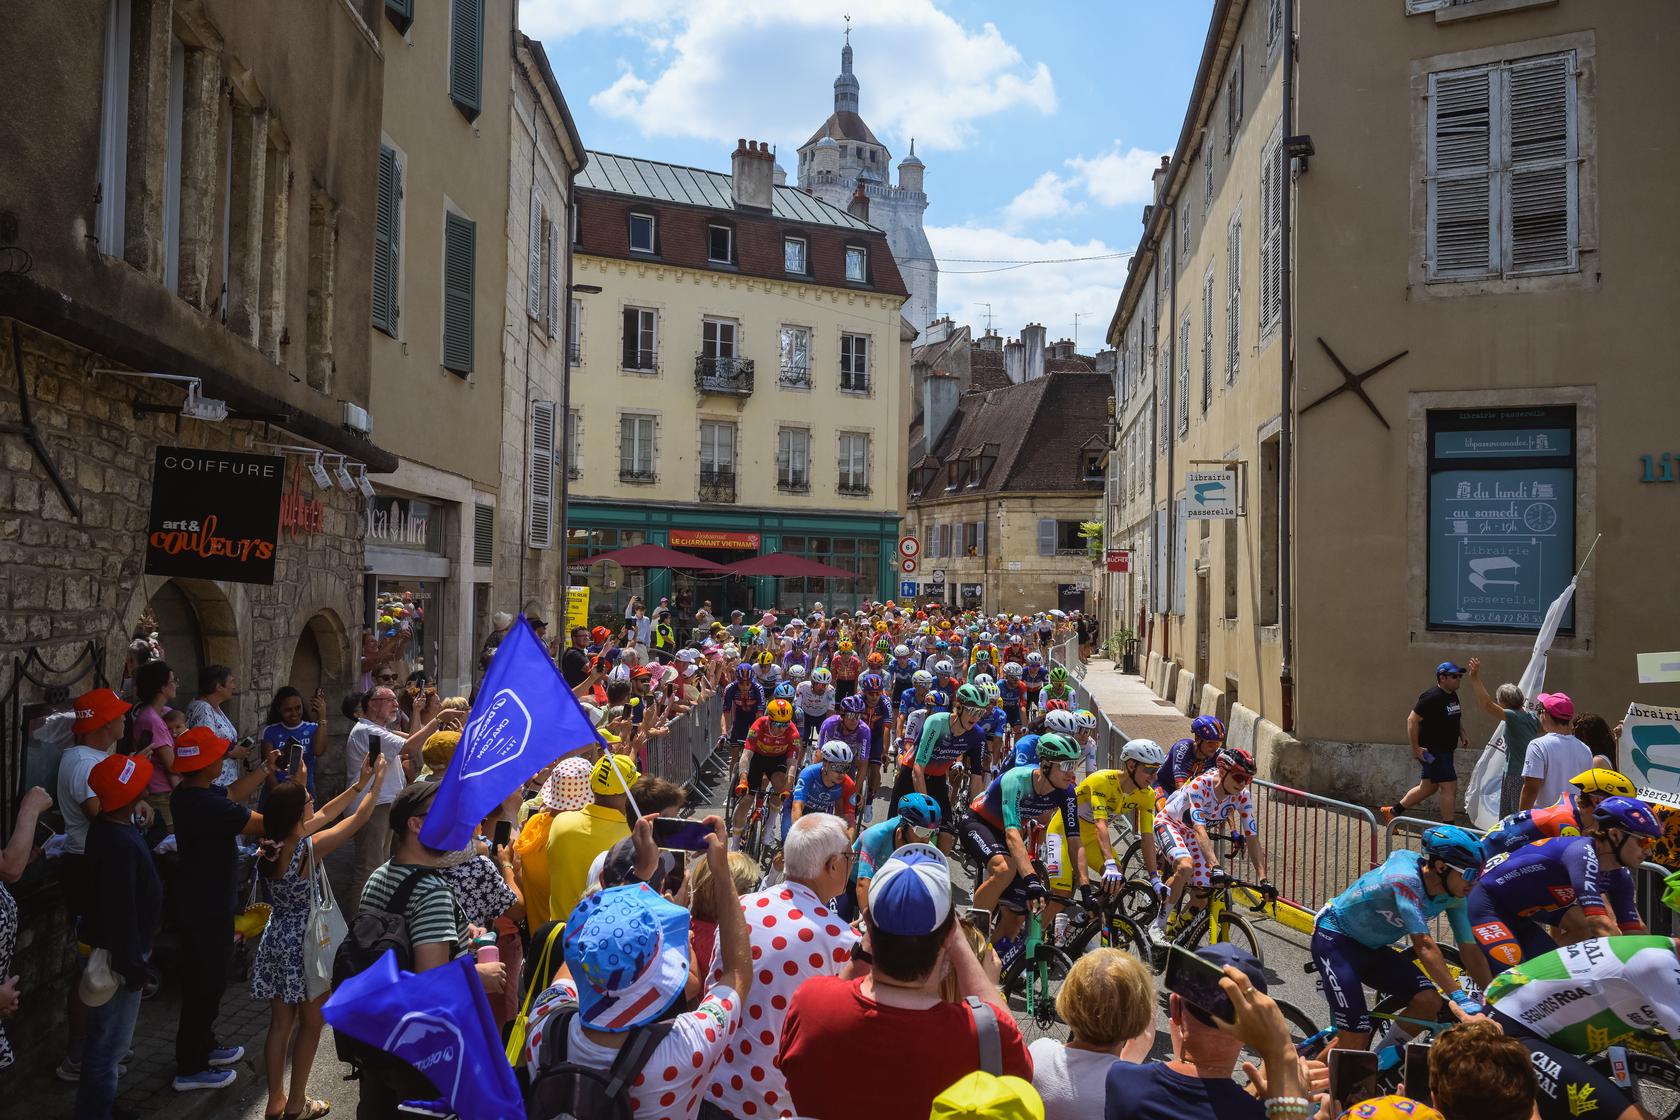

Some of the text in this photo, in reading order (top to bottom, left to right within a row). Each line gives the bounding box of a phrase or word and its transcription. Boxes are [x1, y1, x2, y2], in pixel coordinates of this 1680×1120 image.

[164, 456, 275, 478] COIFFURE
[1639, 452, 1680, 483] li
[1473, 481, 1528, 498] du lundi
[1188, 507, 1234, 518] passerelle
[1453, 501, 1519, 518] au samedi
[1480, 520, 1491, 534] 9h
[1501, 520, 1517, 534] 19h
[680, 539, 720, 547] CHARMANT
[1463, 595, 1536, 605] passerelle
[1628, 706, 1680, 721] ibrairi
[1638, 787, 1680, 805] sserell
[1067, 797, 1076, 827] Adecco
[1504, 869, 1522, 881] HANS
[1520, 863, 1547, 877] ANDERS
[1487, 924, 1507, 938] PIC
[1001, 945, 1019, 965] YSEL
[1567, 943, 1581, 959] GA
[1583, 938, 1605, 966] RAL
[1520, 987, 1592, 1024] SEGUROS RGA
[1530, 1051, 1563, 1081] CAJA
[1533, 1068, 1558, 1099] RAL
